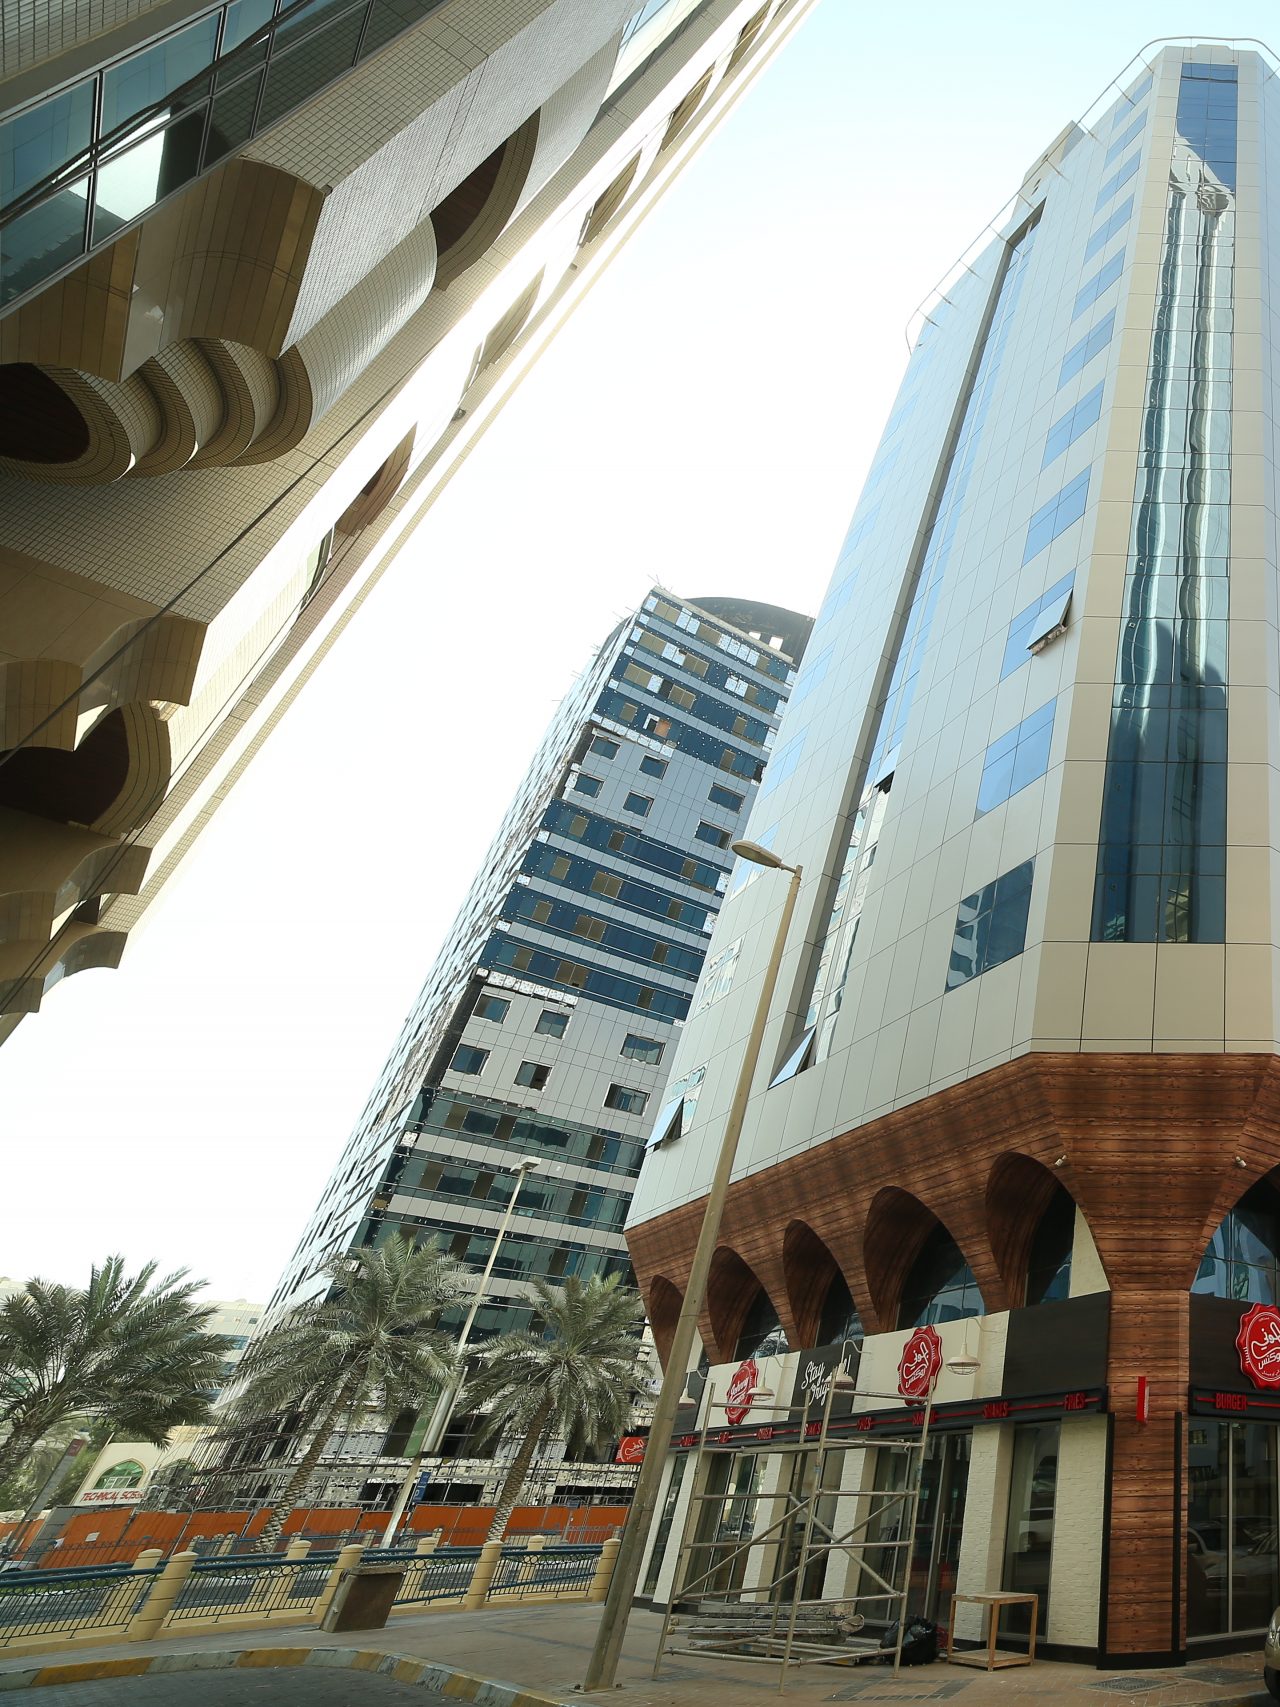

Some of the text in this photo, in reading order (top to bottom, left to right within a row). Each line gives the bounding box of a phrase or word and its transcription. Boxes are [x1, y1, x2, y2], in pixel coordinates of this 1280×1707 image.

[801, 1360, 826, 1390] Stay
[1215, 1392, 1248, 1411] BURGER
[80, 1491, 118, 1502] TECHNICAL
